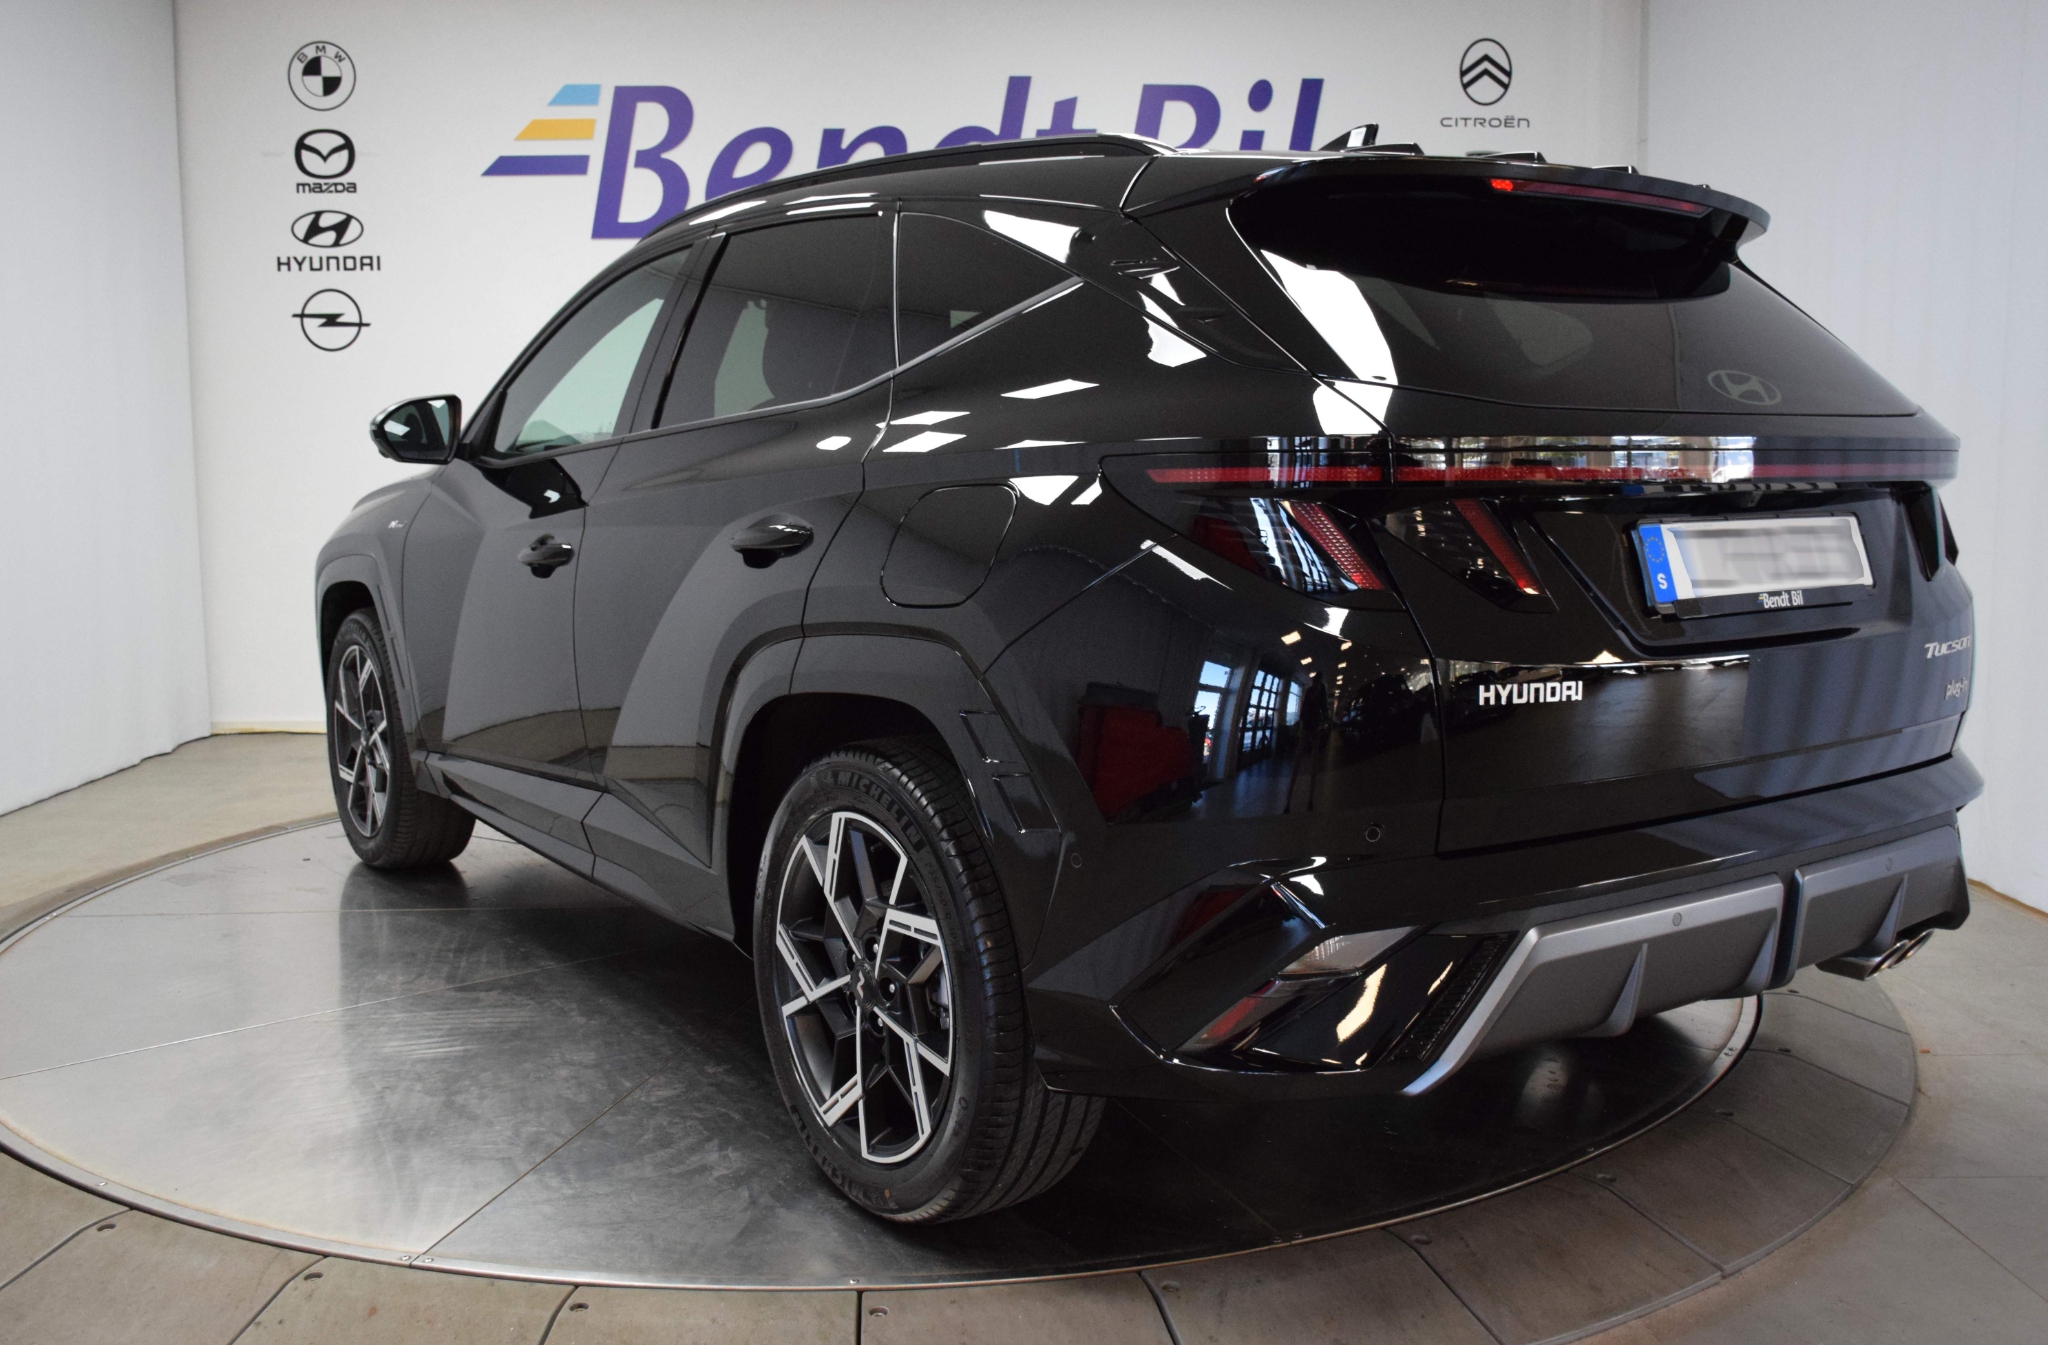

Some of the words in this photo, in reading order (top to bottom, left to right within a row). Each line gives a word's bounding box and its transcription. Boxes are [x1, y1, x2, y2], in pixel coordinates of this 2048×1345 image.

[296, 45, 347, 63] BMW
[276, 255, 381, 272] HYUNDAI
[1657, 573, 1668, 590] S
[1763, 590, 1791, 609] Bendt
[1790, 590, 1804, 606] Bil
[1478, 680, 1583, 706] HYUNDAI
[838, 771, 922, 843] MICHELIN
